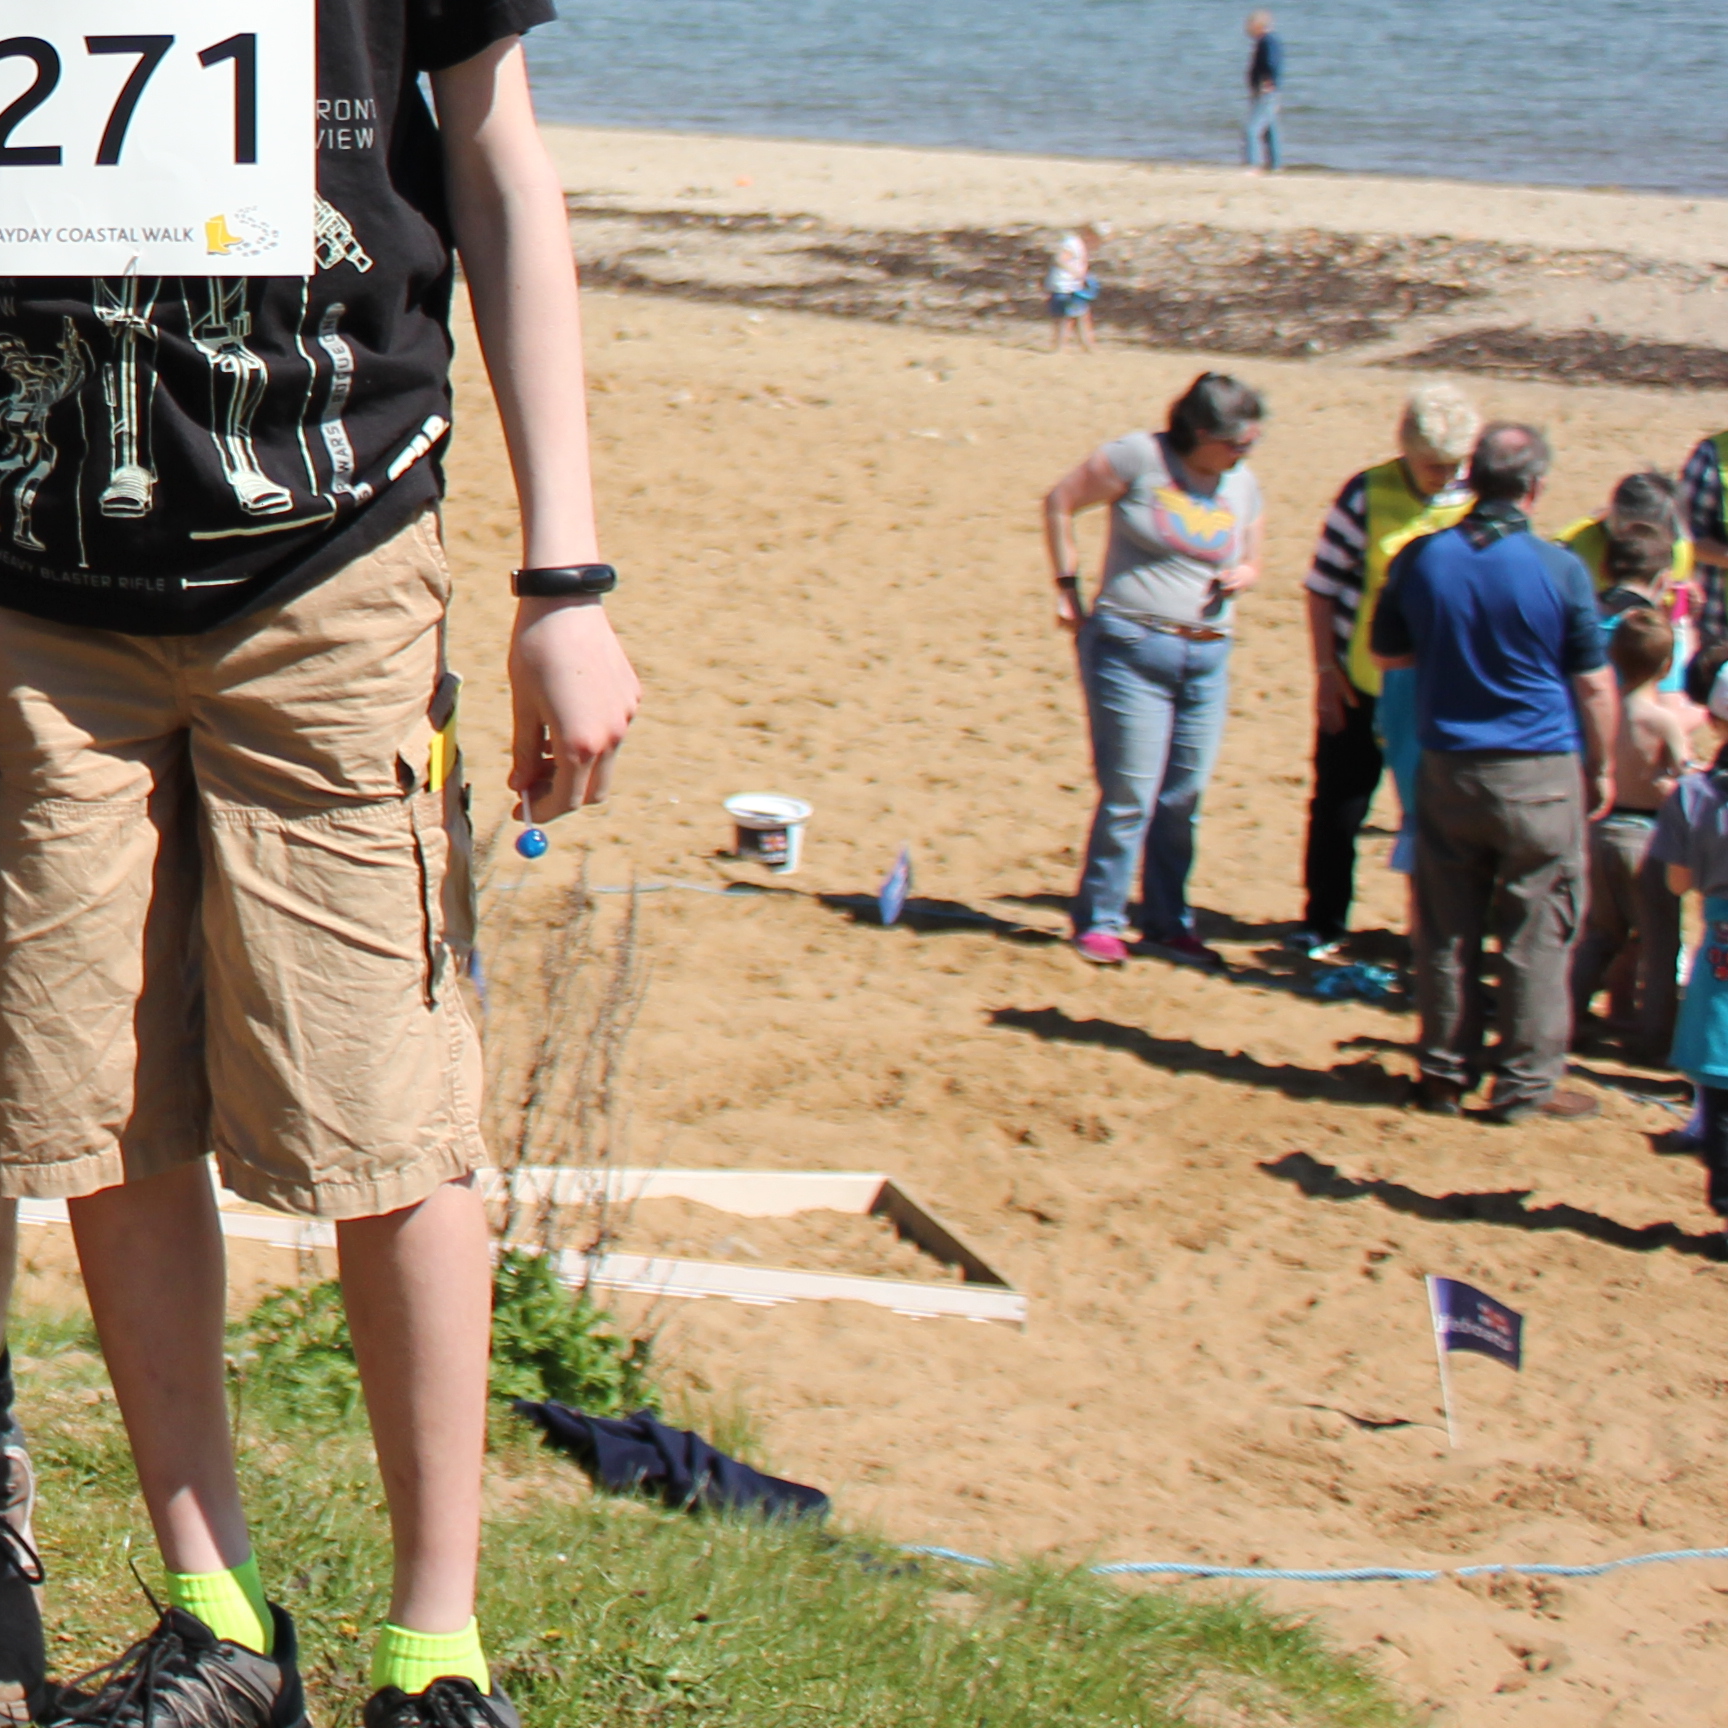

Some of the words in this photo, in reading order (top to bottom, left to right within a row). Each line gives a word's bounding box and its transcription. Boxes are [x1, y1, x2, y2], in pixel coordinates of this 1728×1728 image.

[56, 227, 139, 243] COASTAL
[142, 227, 195, 243] WALK
[326, 425, 351, 472] WARS
[40, 567, 113, 588] BLASTER
[119, 576, 166, 592] RIFLE
